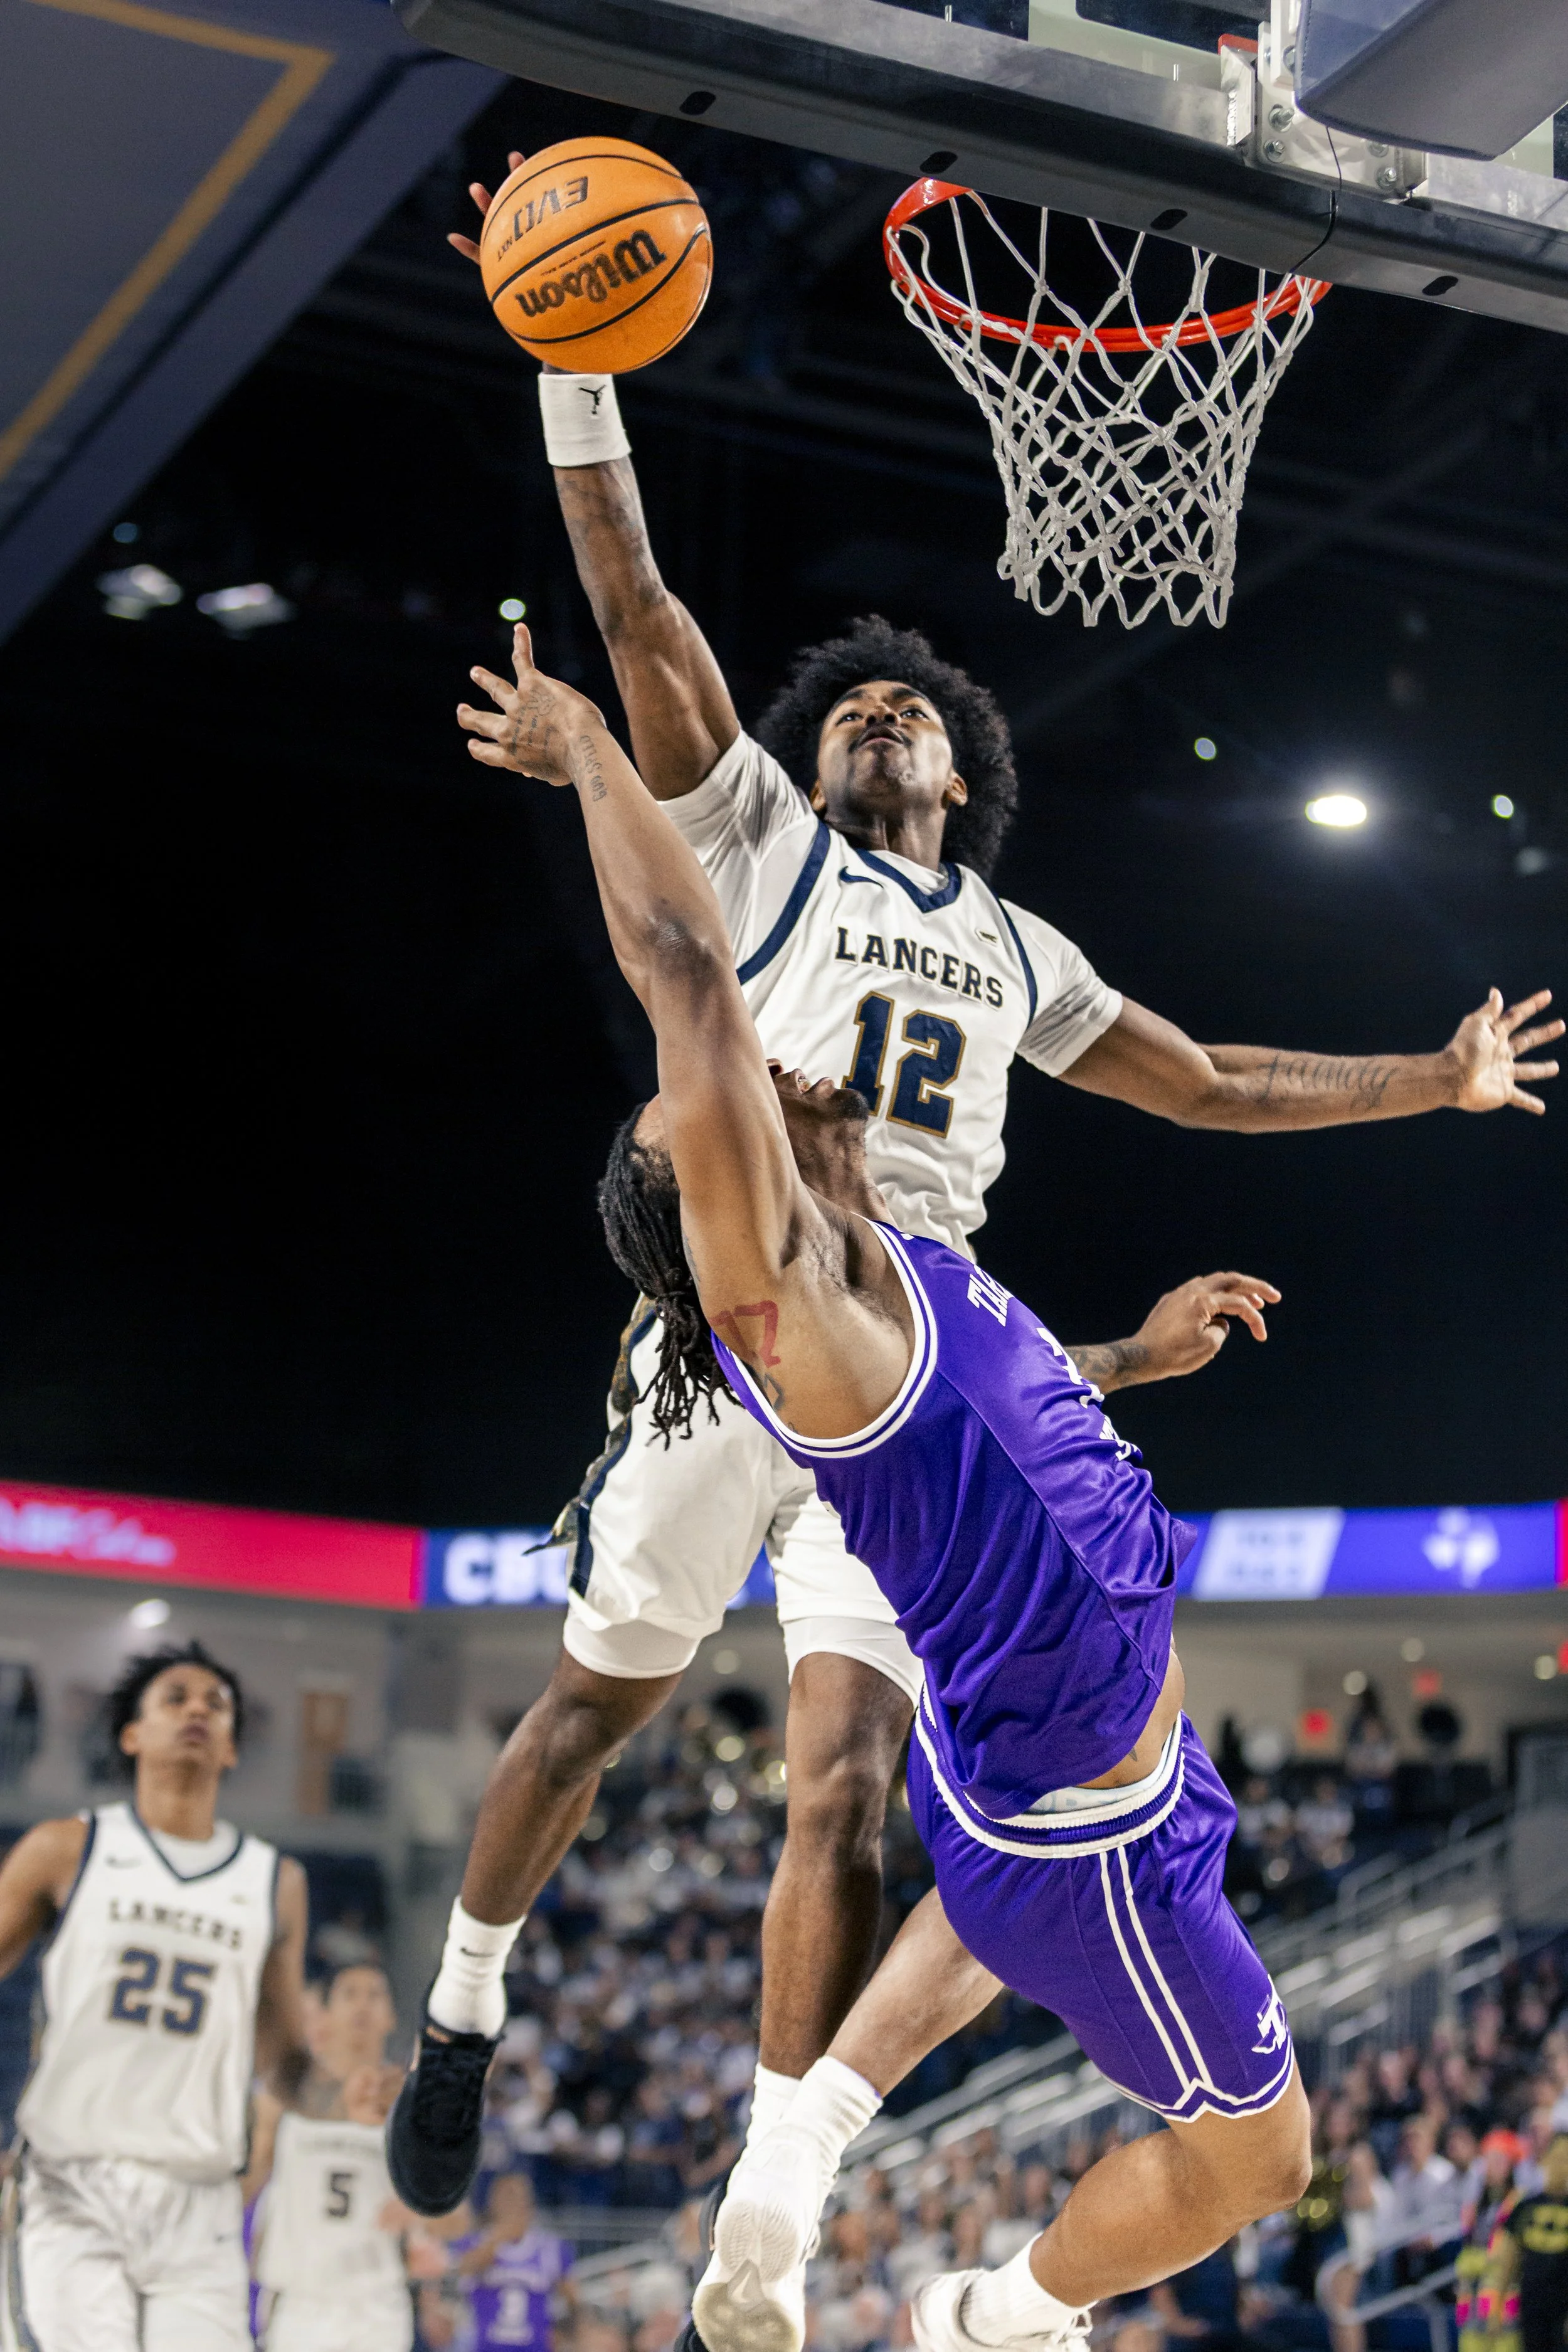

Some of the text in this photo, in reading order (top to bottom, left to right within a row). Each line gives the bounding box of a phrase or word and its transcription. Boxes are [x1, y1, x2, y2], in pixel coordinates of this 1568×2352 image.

[512, 176, 588, 242] EVO
[514, 230, 667, 317] Wilson
[834, 926, 1003, 1009] LANCERS
[840, 990, 967, 1139] 12
[107, 1897, 245, 1951] LANCERS
[108, 1946, 217, 2038] 25
[325, 2169, 356, 2220] 5
